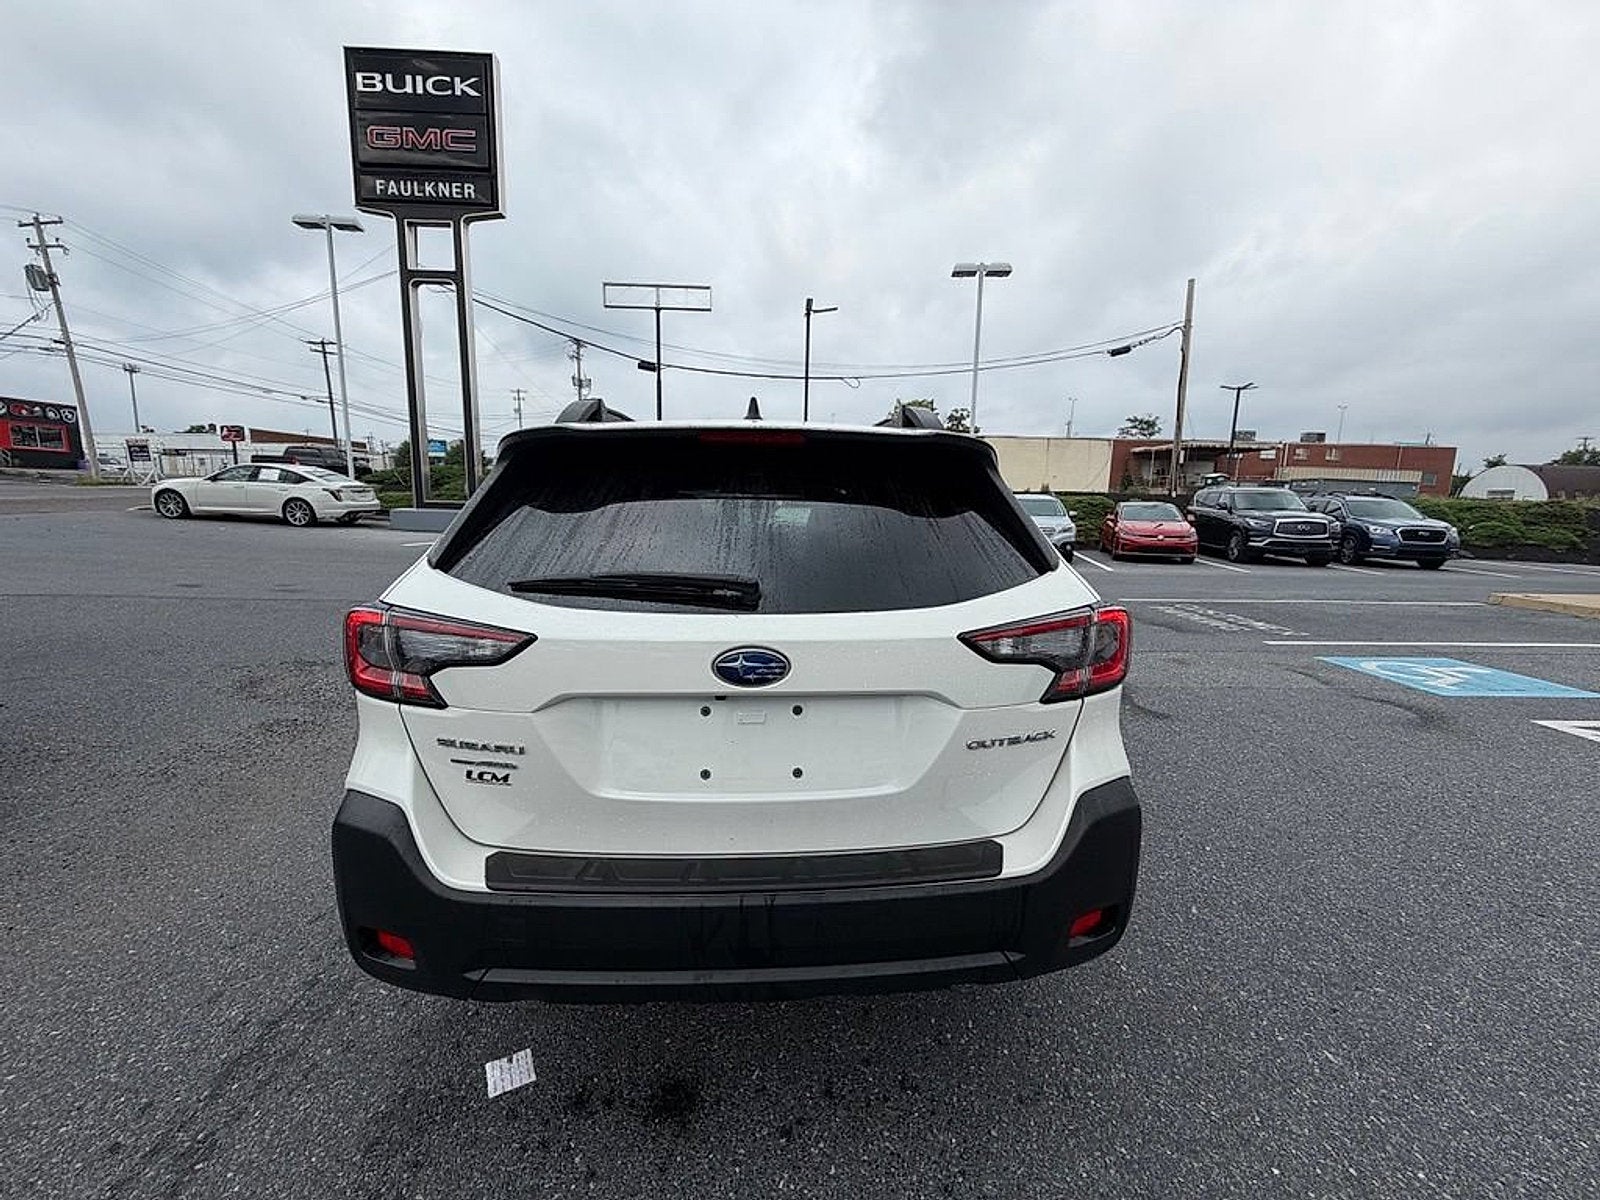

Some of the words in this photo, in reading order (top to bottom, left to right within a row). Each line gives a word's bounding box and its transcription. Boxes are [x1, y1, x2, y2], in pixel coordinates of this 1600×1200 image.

[355, 72, 481, 96] BUICK
[367, 125, 476, 151] GMC
[375, 179, 475, 199] FAULKNER
[436, 738, 526, 755] SUBARU
[966, 730, 1056, 750] OUTBACK
